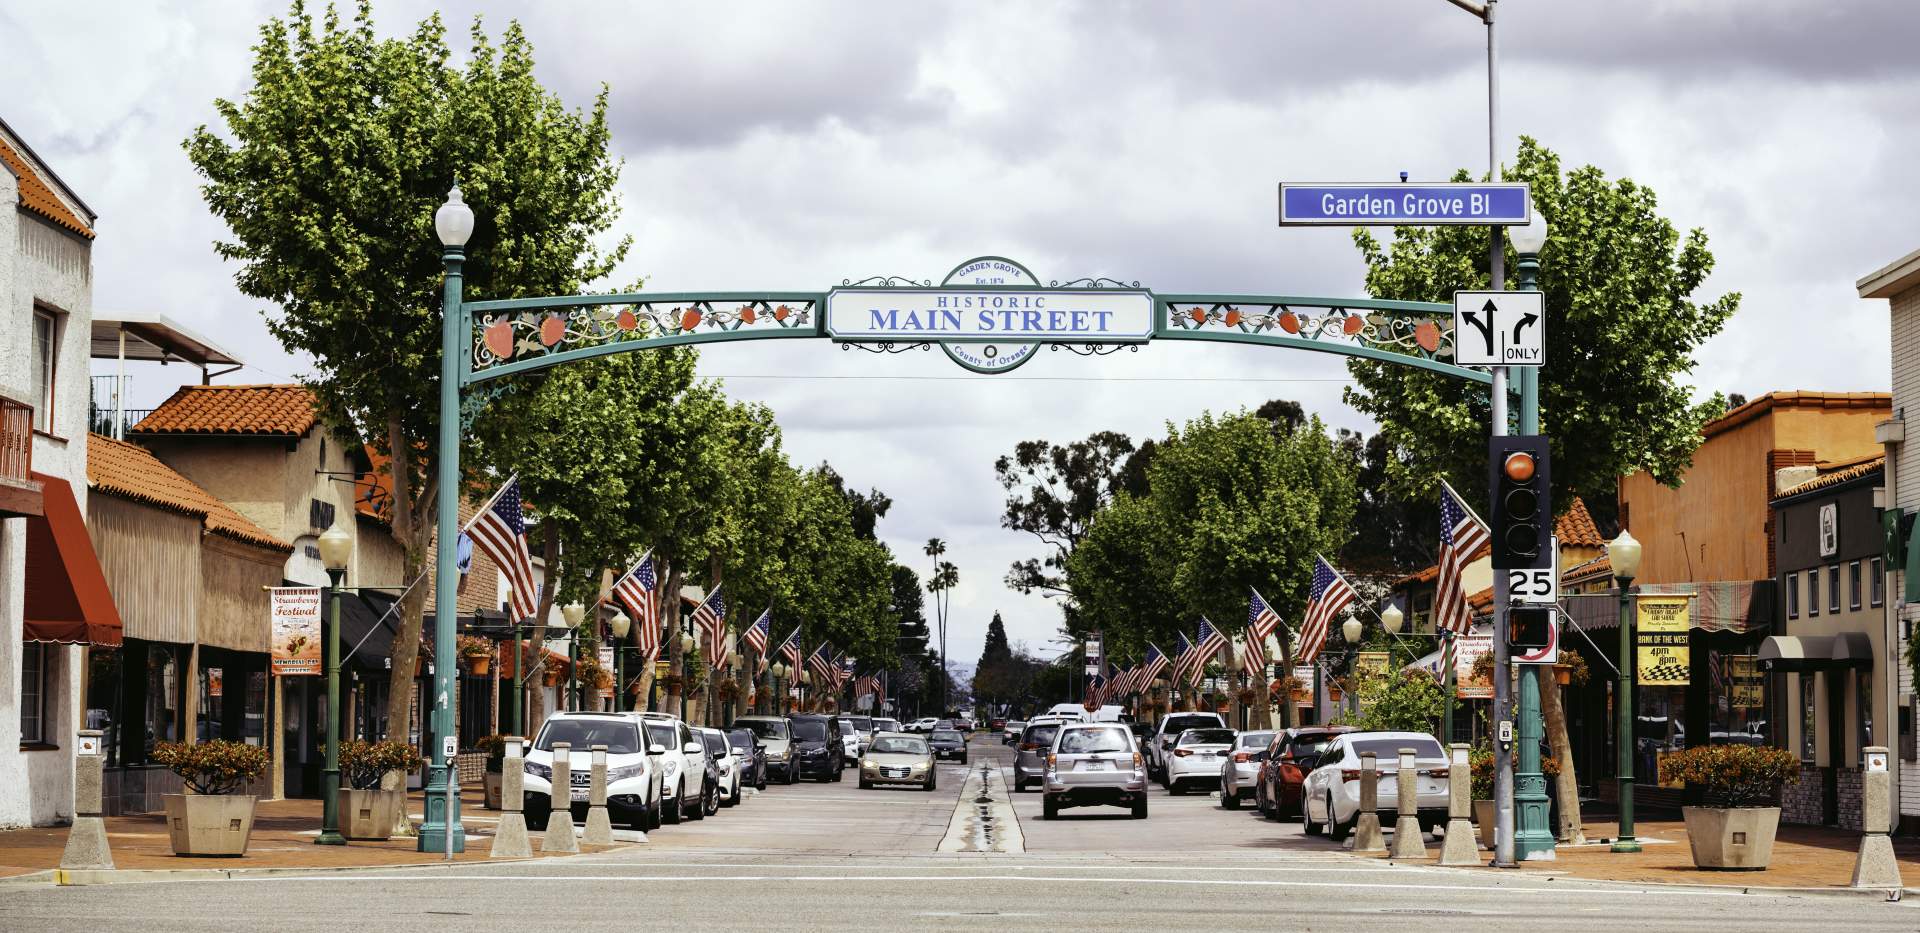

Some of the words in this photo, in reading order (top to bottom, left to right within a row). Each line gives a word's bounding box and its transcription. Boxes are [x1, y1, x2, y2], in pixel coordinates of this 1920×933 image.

[1321, 193, 1395, 215] Garden
[1403, 193, 1463, 215] Grove
[1471, 193, 1489, 215] Bl
[959, 262, 991, 276] GARDEN
[994, 263, 1021, 277] GROVE
[975, 277, 988, 285] Est.
[990, 277, 1004, 285] 1874
[937, 296, 1046, 308] HISTORIC
[868, 309, 962, 330] MAIN
[978, 310, 1113, 331] STREET
[954, 345, 982, 366] County
[1000, 345, 1028, 364] Orange
[1506, 348, 1539, 360] ONLY
[1510, 571, 1552, 596] 25
[274, 596, 318, 605] Strawberry
[274, 606, 317, 616] Festival
[1638, 635, 1653, 644] BANK
[1654, 635, 1661, 644] OF
[1662, 635, 1672, 644] THE
[1673, 635, 1688, 644] WEST
[1651, 647, 1669, 657] 4pm
[1659, 656, 1677, 666] 8pm
